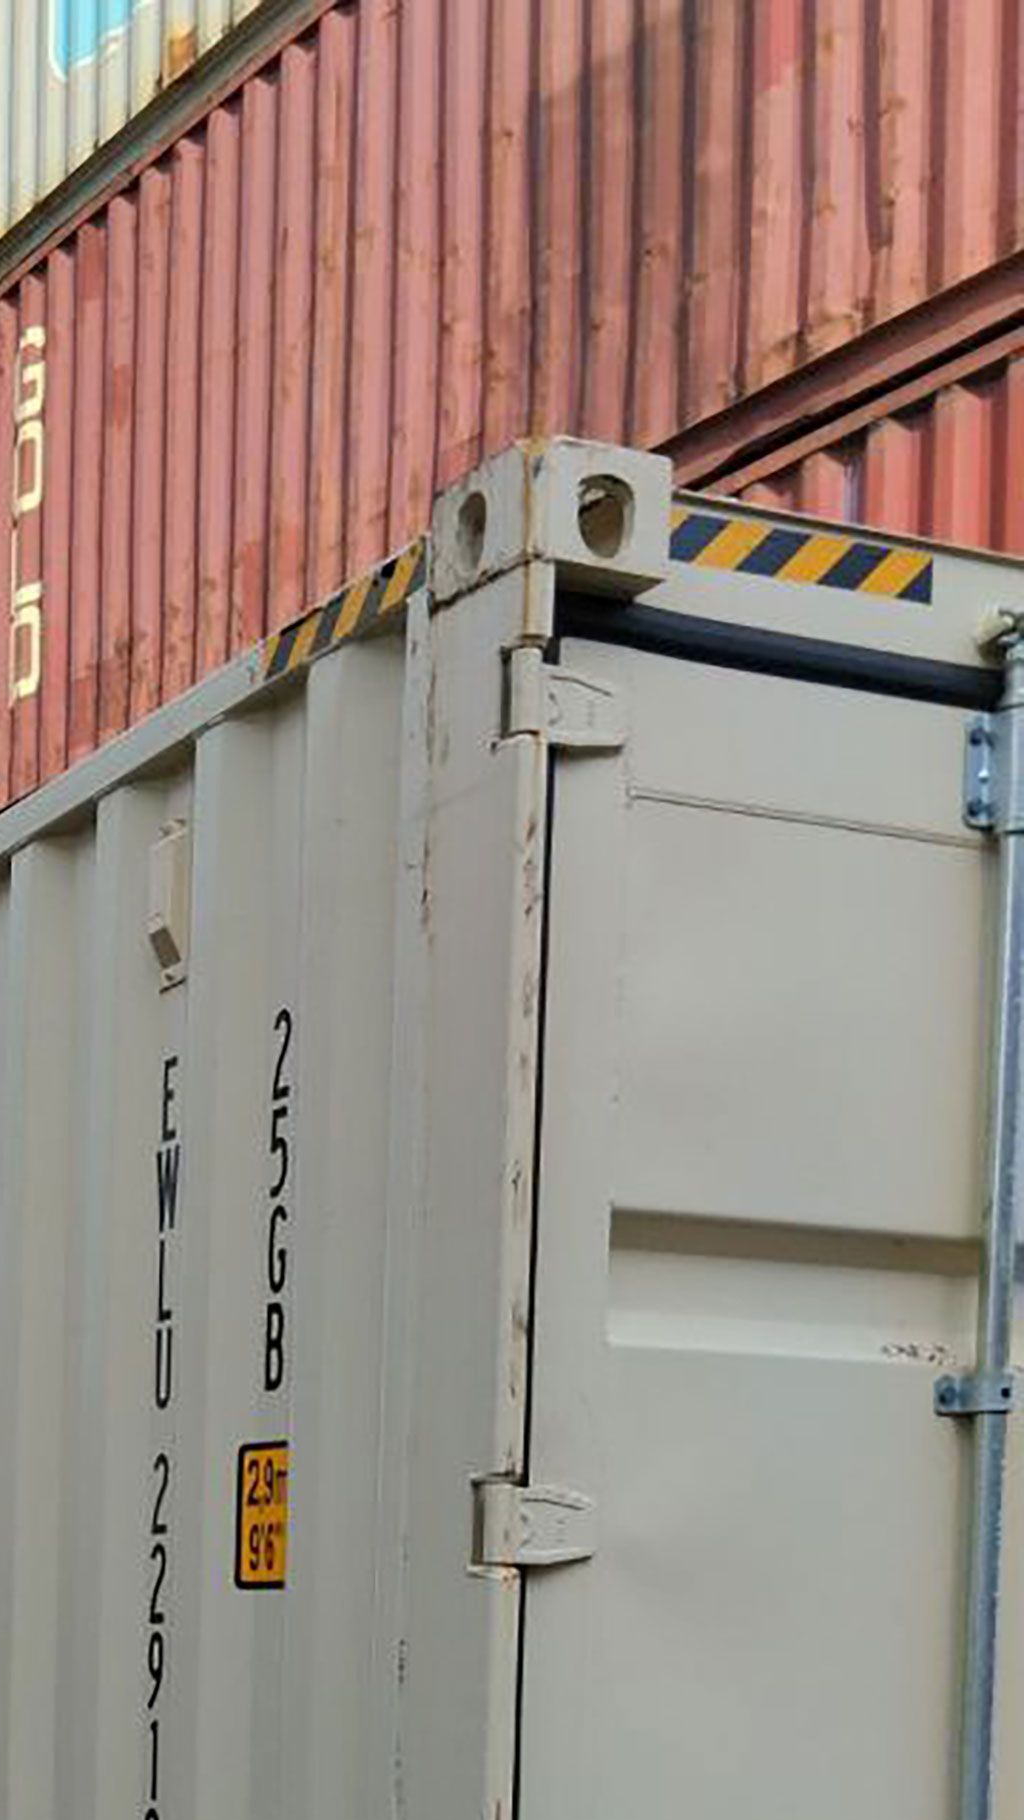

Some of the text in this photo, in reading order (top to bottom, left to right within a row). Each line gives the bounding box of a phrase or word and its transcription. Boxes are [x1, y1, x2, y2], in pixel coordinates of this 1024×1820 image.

[10, 325, 46, 707] GOLD
[156, 1056, 179, 1411] EWLU
[264, 1008, 292, 1392] 25GB
